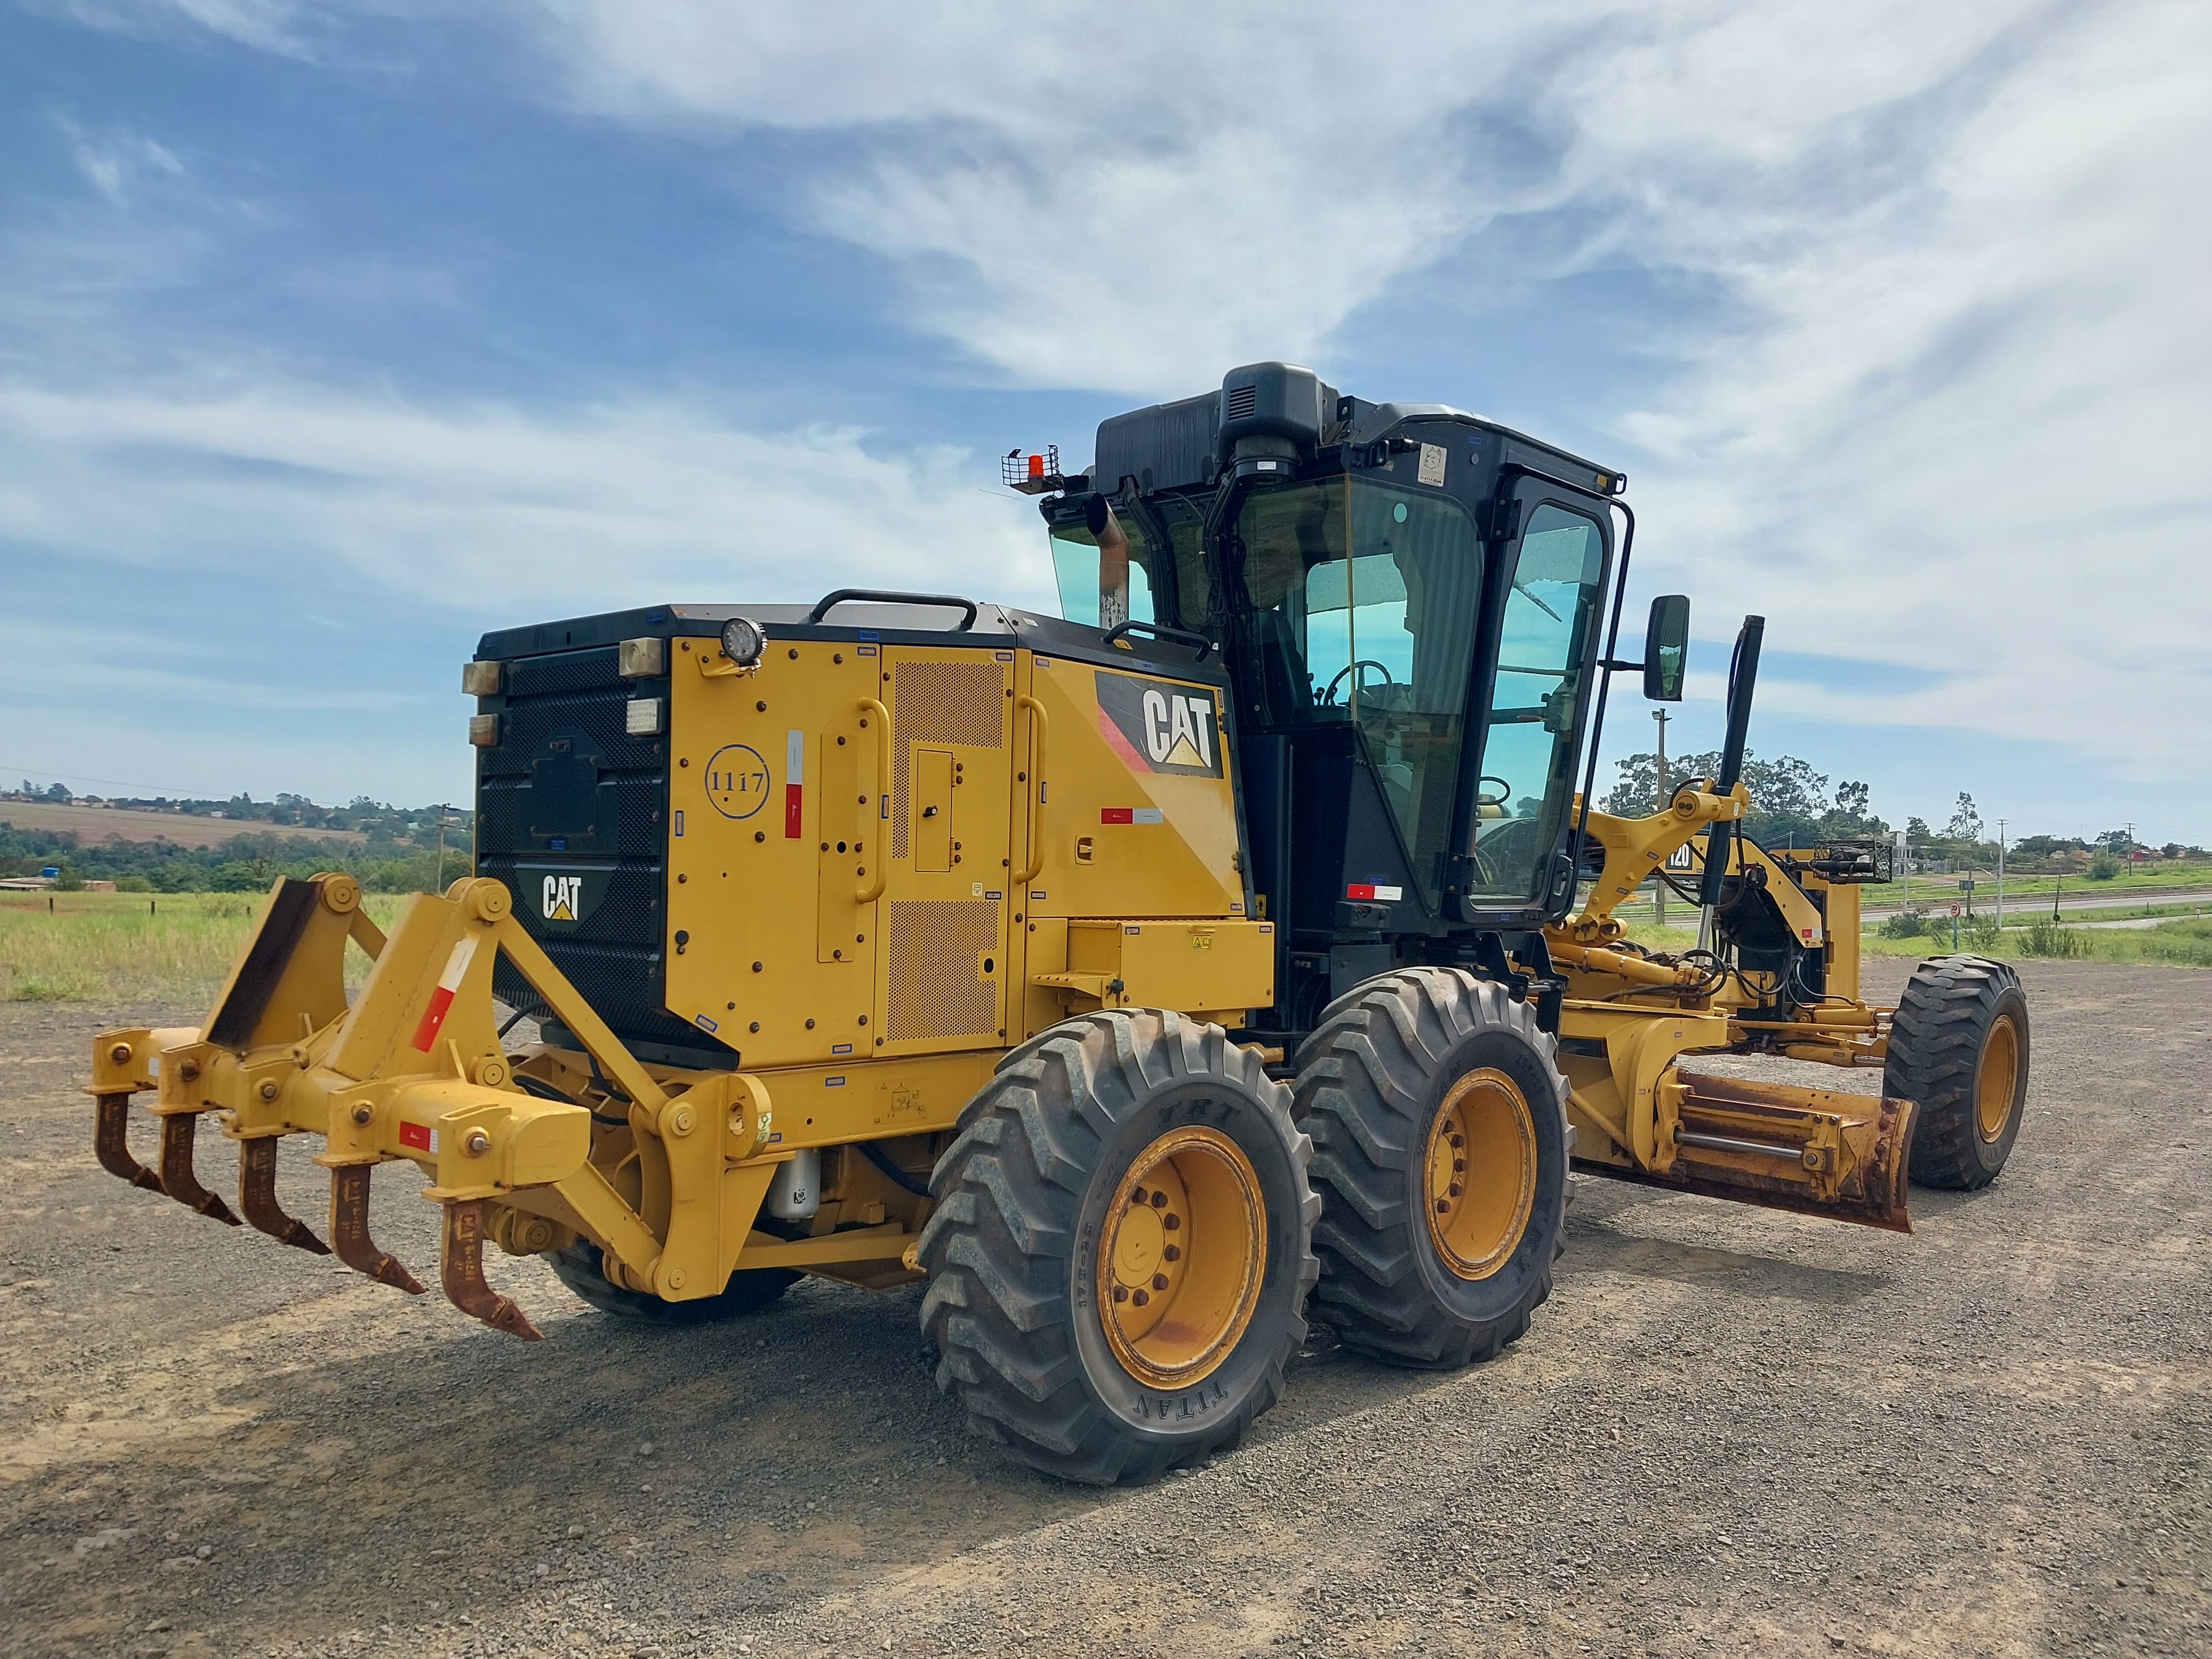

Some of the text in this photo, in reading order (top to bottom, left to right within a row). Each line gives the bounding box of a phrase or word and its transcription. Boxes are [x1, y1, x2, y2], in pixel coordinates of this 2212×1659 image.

[1143, 690, 1211, 768] CAT
[710, 771, 764, 793] 1117
[543, 875, 582, 921] CAT
[1158, 1097, 1242, 1131] TRT
[1078, 1221, 1093, 1308] 17.5-25
[1132, 1378, 1228, 1421] TITAN
